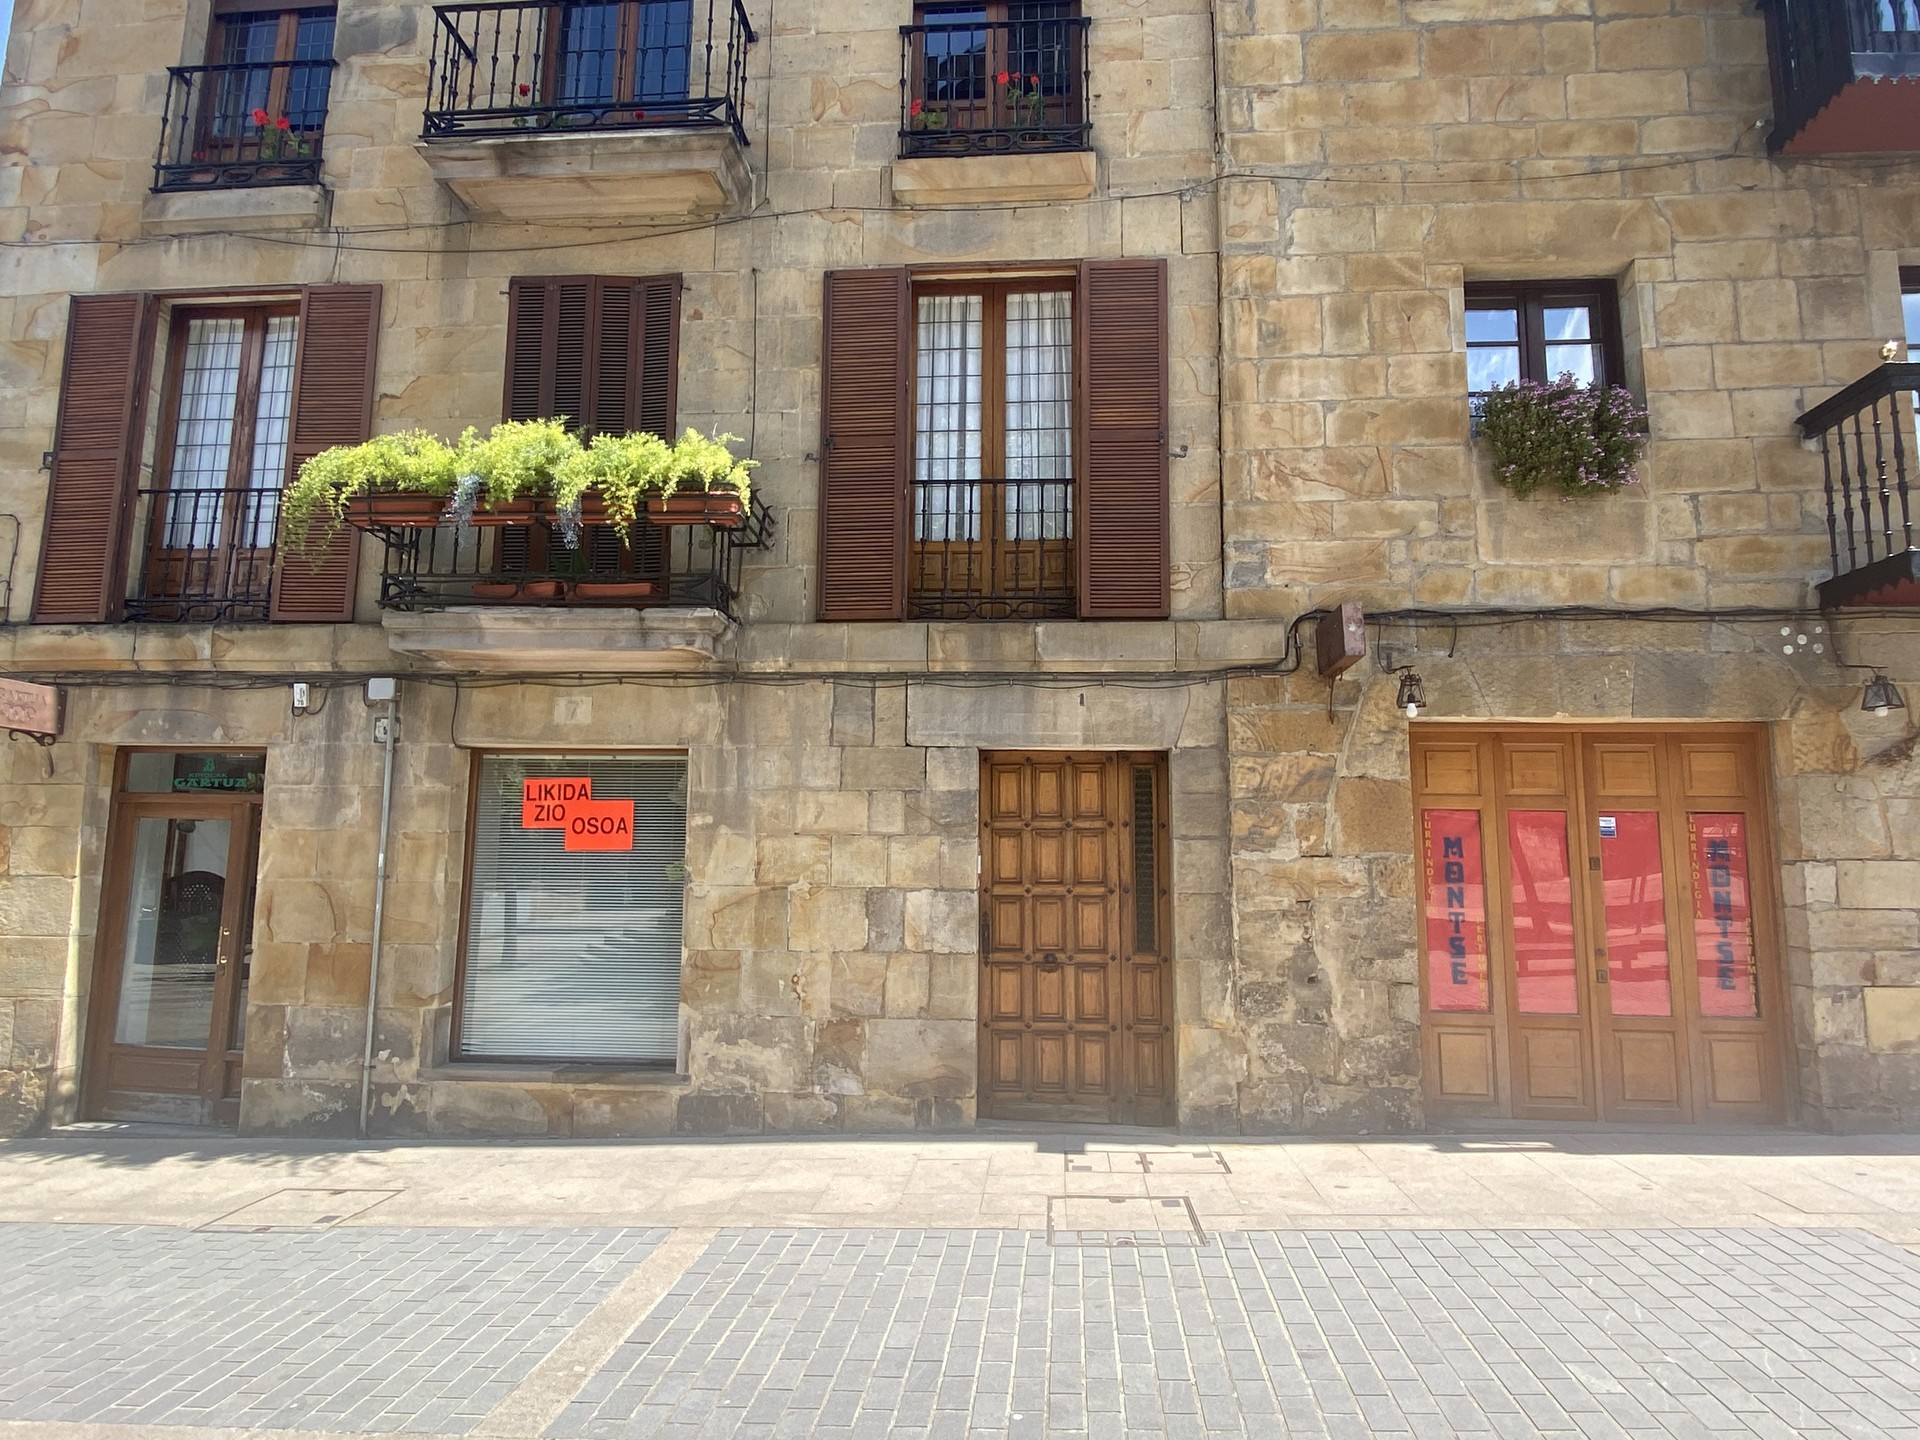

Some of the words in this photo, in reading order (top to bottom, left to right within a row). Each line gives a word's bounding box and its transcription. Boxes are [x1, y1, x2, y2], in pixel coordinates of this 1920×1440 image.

[174, 778, 247, 788] GARTUA
[526, 784, 589, 802] LIKIDA
[534, 804, 566, 822] ZIO
[571, 817, 628, 835] OSOA
[1689, 815, 1703, 918] LURRINDEGIA
[1443, 837, 1468, 984] MONTSE
[1706, 840, 1736, 991] MONTSE
